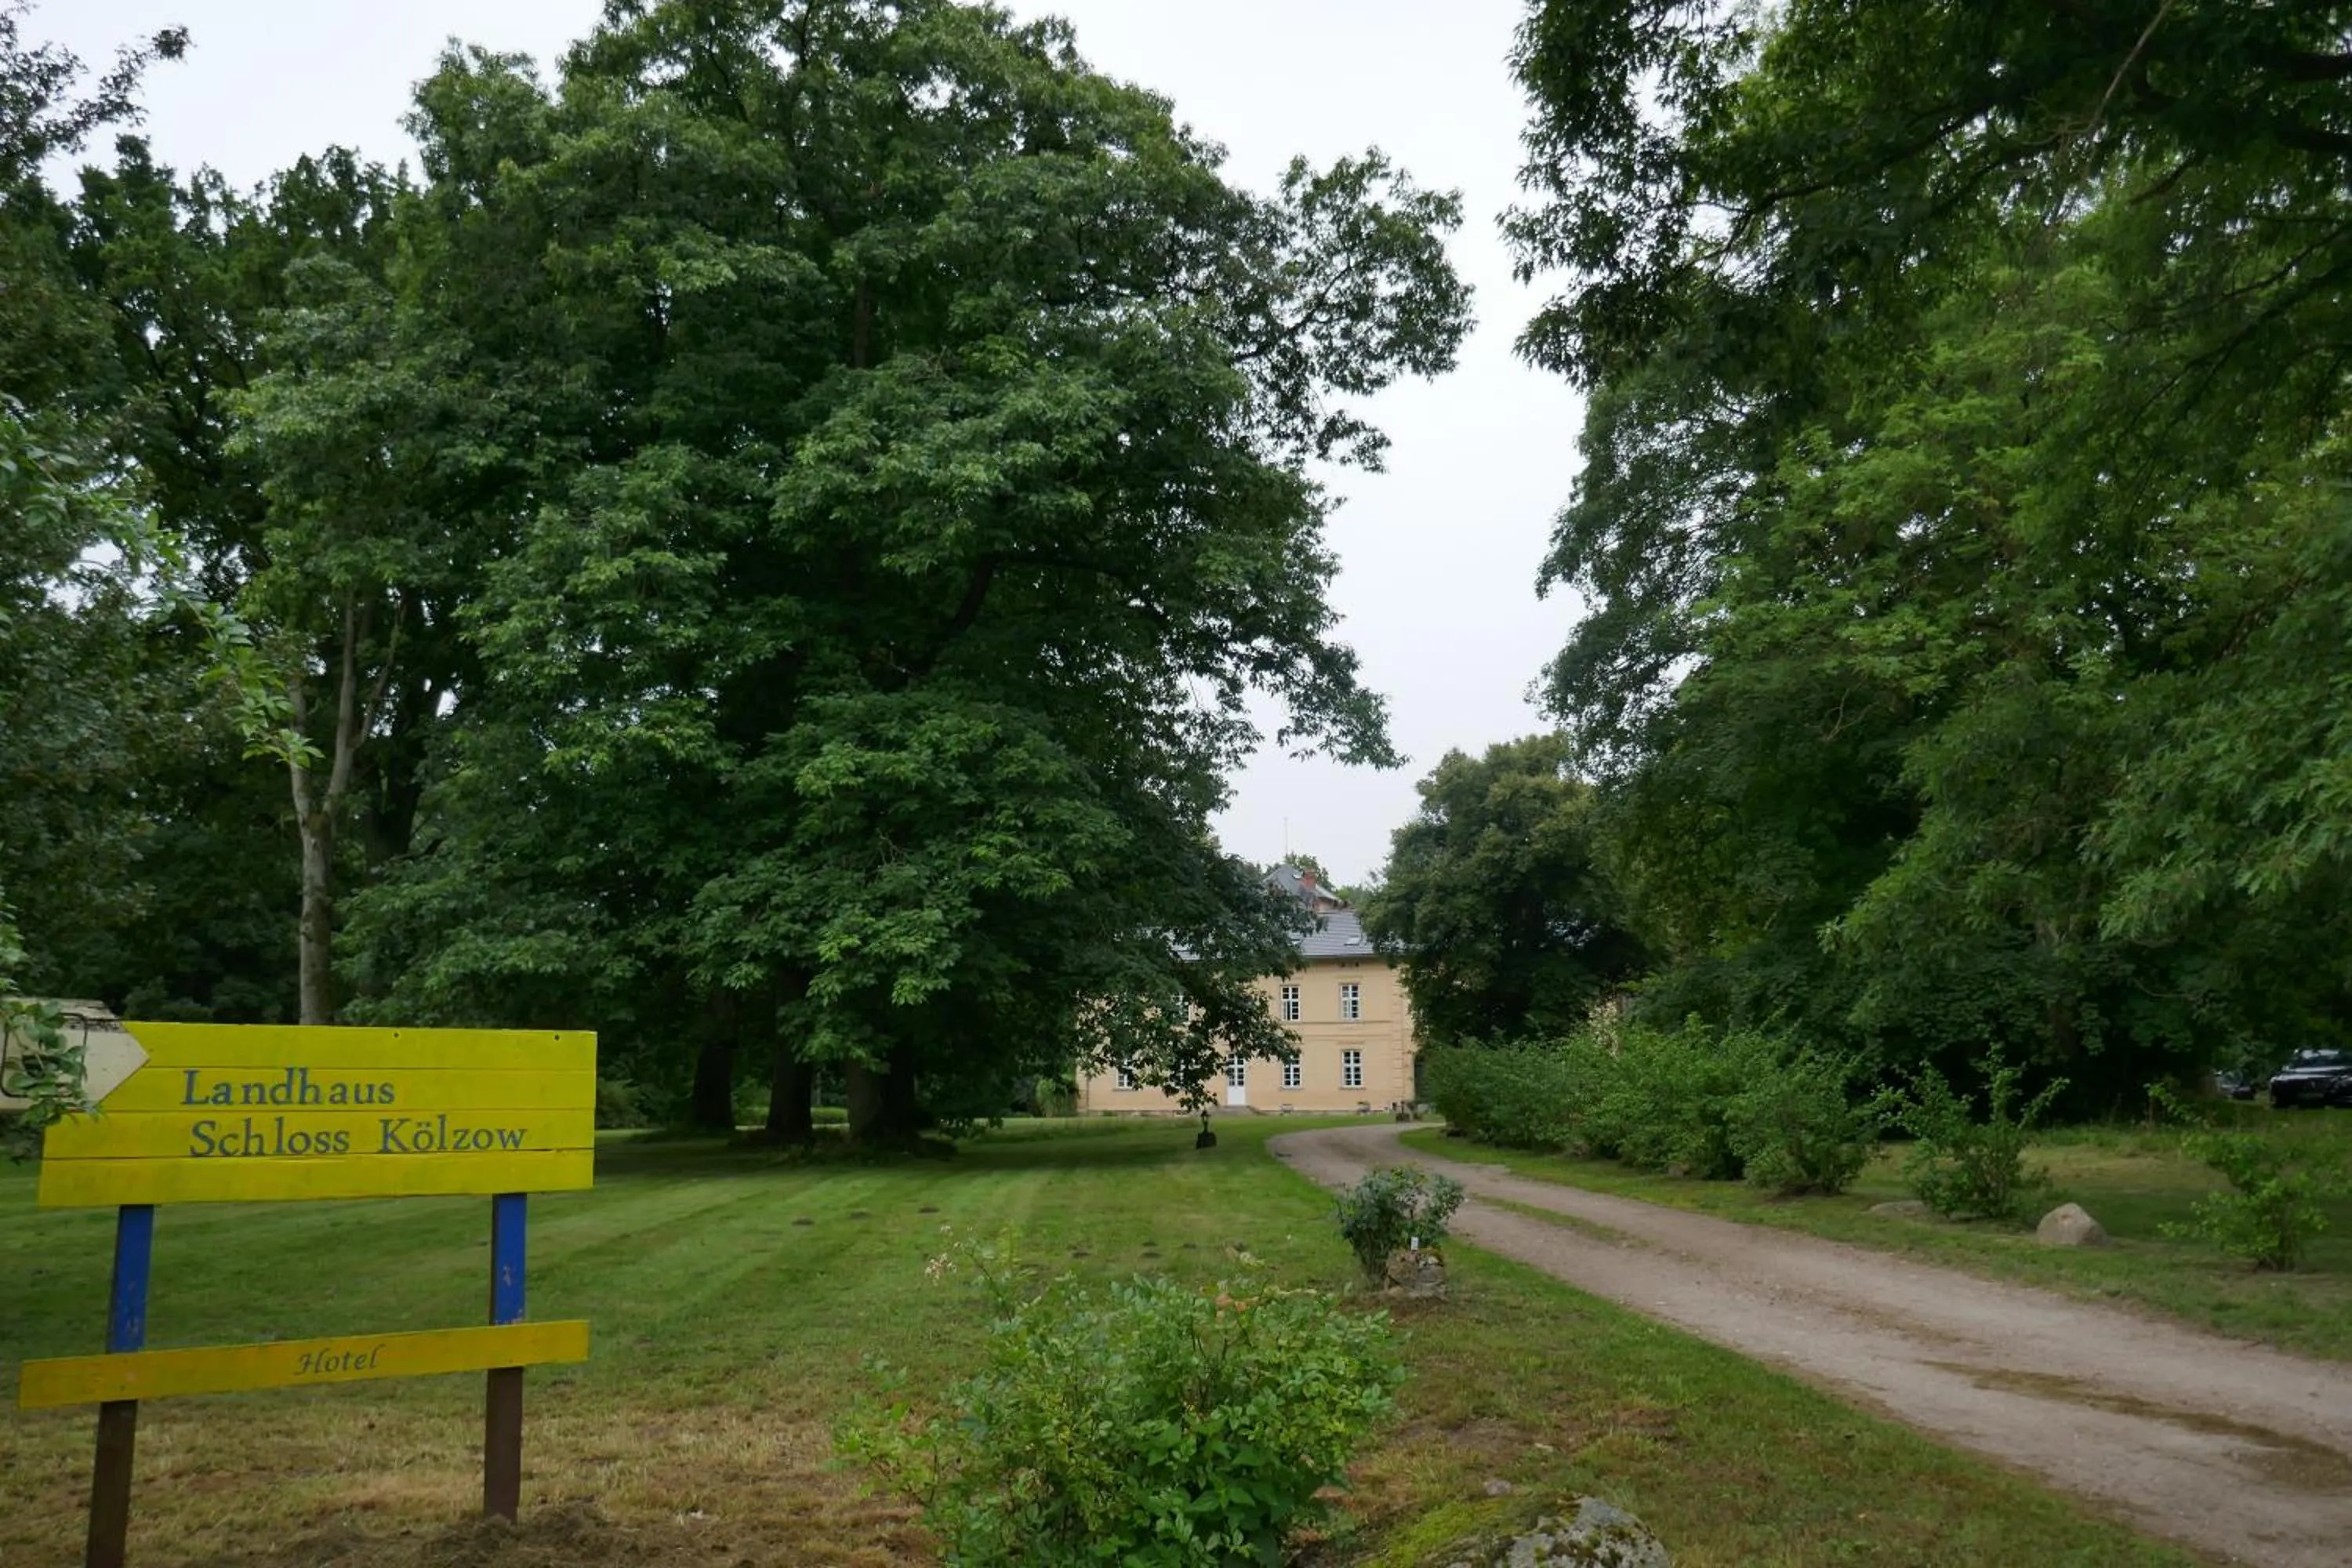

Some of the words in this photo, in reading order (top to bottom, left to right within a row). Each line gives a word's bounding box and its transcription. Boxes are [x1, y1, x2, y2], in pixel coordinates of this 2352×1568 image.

[181, 1067, 395, 1105] Landhaus
[190, 1116, 350, 1156] Schloss
[378, 1114, 527, 1153] Kölzow
[294, 1343, 386, 1375] Hotel
